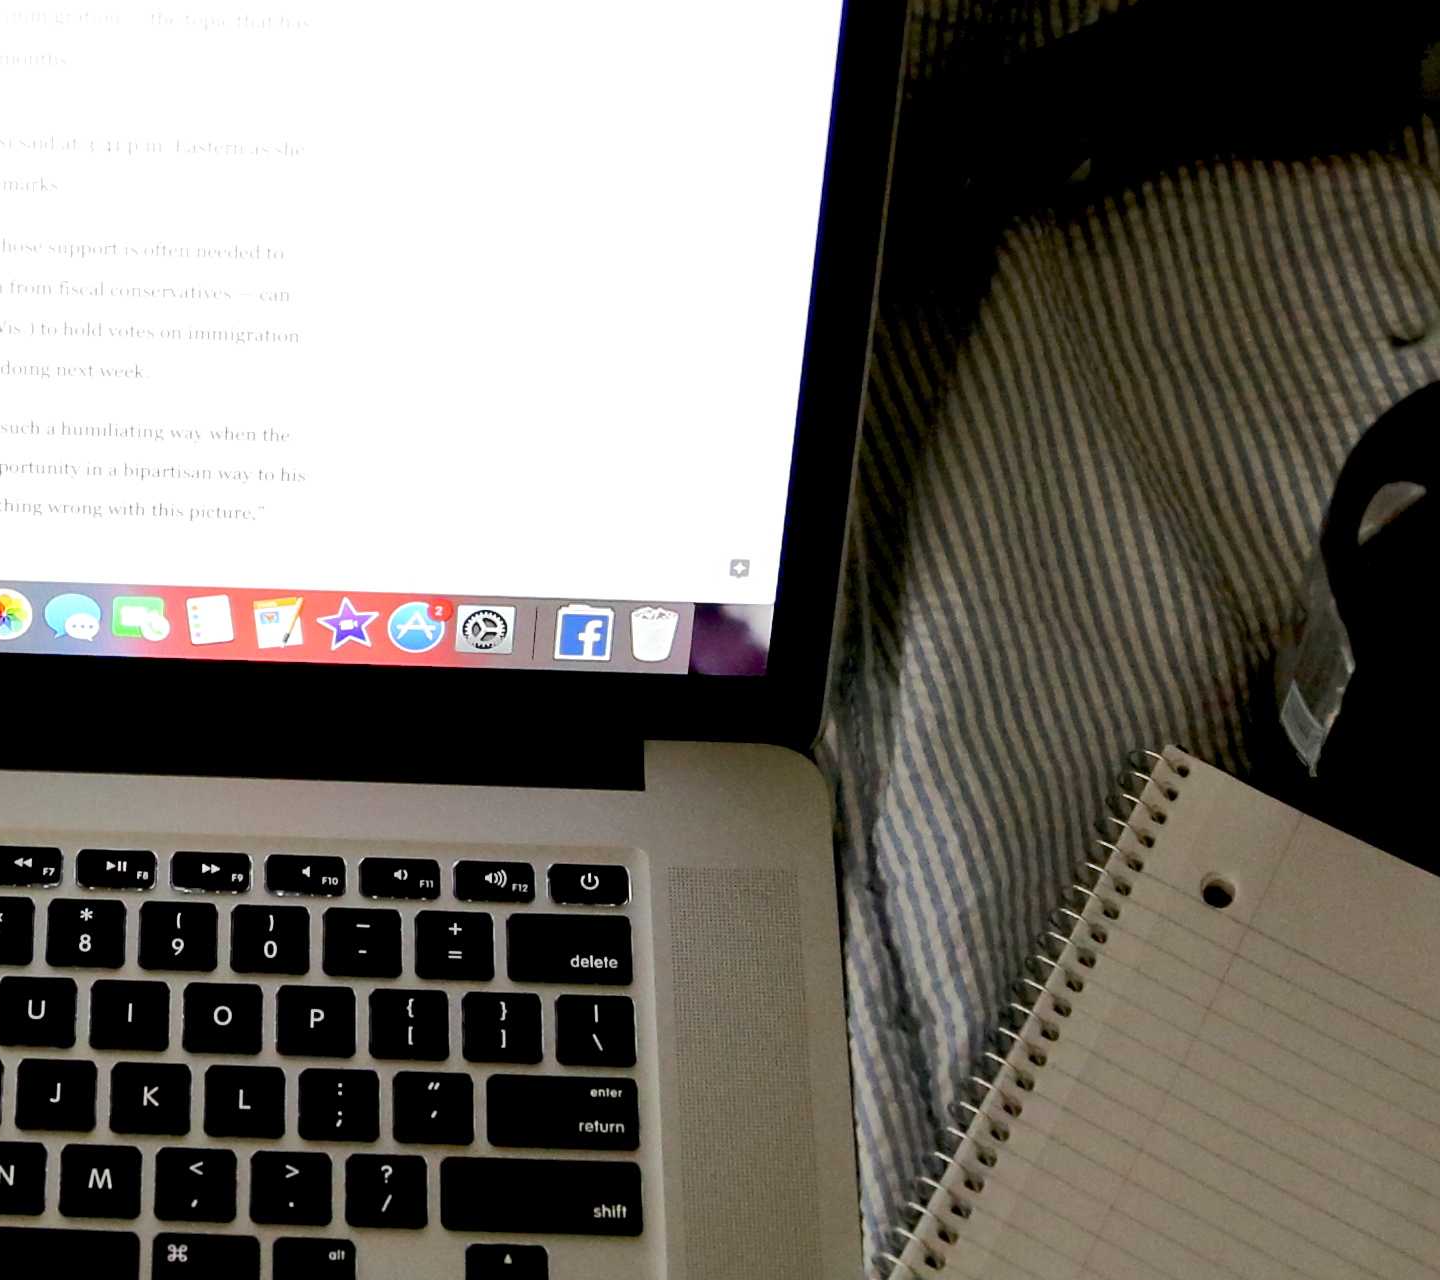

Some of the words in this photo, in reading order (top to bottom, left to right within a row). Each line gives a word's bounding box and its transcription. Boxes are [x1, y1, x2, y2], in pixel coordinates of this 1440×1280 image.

[1, 417, 39, 435] such
[62, 419, 164, 442] humiliating
[170, 428, 200, 443] way
[210, 423, 256, 441] when
[264, 424, 290, 442] the
[87, 461, 102, 477] in
[124, 460, 211, 484] bipartisan
[214, 469, 252, 485] way
[259, 467, 274, 482] to
[281, 465, 305, 483] his
[48, 503, 102, 519] wrong
[109, 498, 144, 516] with
[152, 500, 184, 518] this
[42, 867, 56, 877] F7
[136, 870, 149, 880] F8
[231, 873, 244, 883] F9
[321, 876, 339, 886] F10
[419, 879, 434, 889] F11
[511, 883, 529, 893] F12
[78, 933, 92, 953] 8
[171, 937, 185, 956] 9
[263, 940, 278, 959] 0
[570, 954, 619, 969] delete
[27, 999, 46, 1020] U
[213, 1005, 233, 1026] O
[309, 1008, 325, 1029] P
[49, 1082, 62, 1104] J
[142, 1085, 160, 1107] K
[238, 1088, 252, 1110] L
[589, 1087, 623, 1098] enter
[578, 1120, 625, 1134] return
[88, 1167, 113, 1190] M
[593, 1203, 627, 1219] shift
